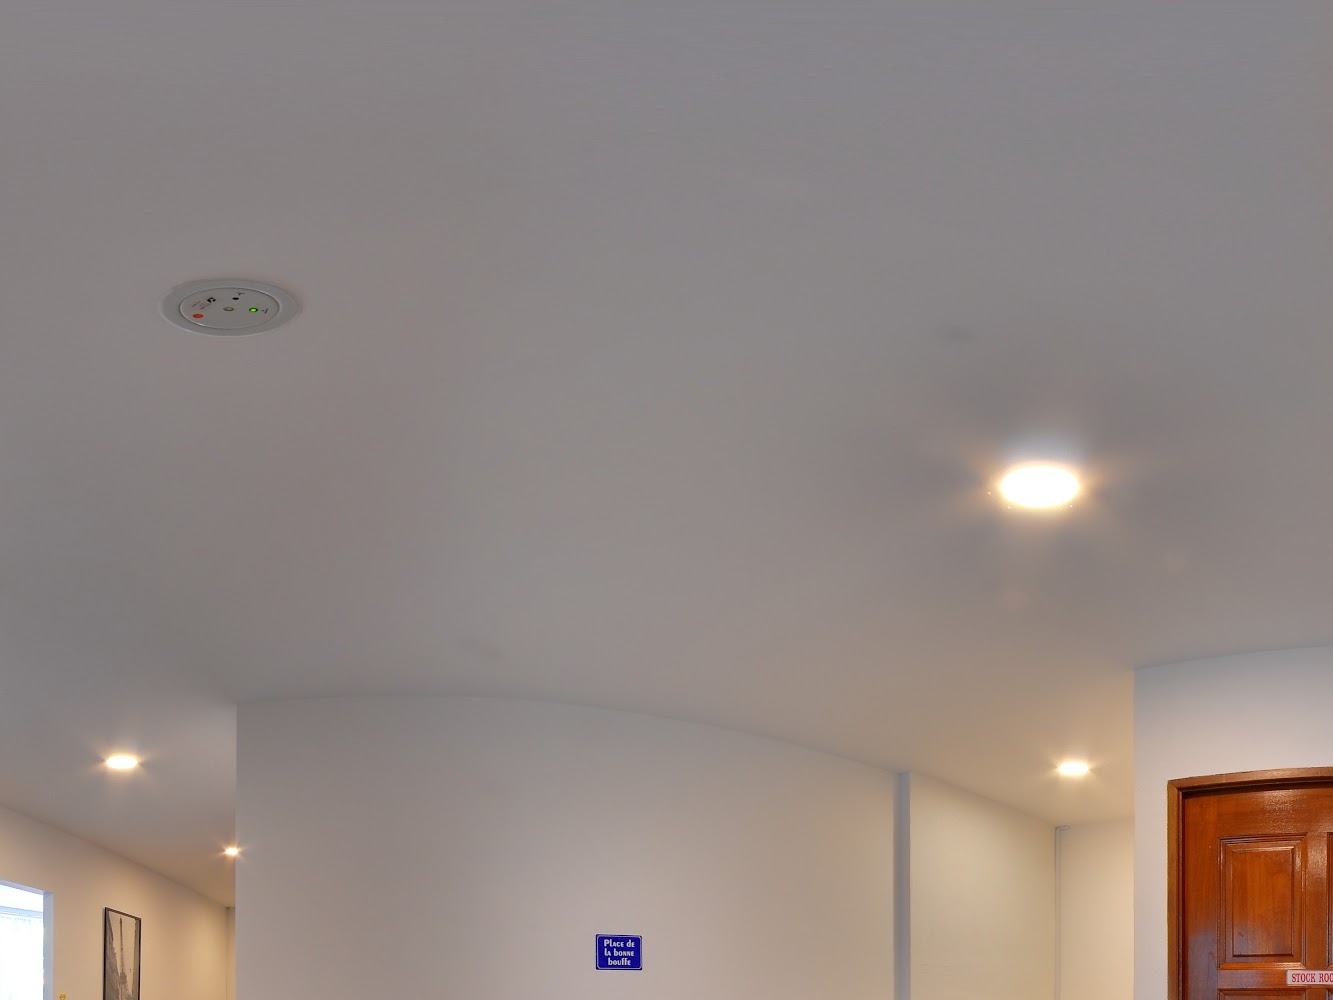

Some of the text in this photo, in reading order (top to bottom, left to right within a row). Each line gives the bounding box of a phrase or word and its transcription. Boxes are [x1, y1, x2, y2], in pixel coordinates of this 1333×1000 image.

[603, 939, 635, 948] Place de
[604, 948, 635, 956] la bonne
[607, 957, 631, 966] bouffe
[1291, 973, 1316, 983] STOCK
